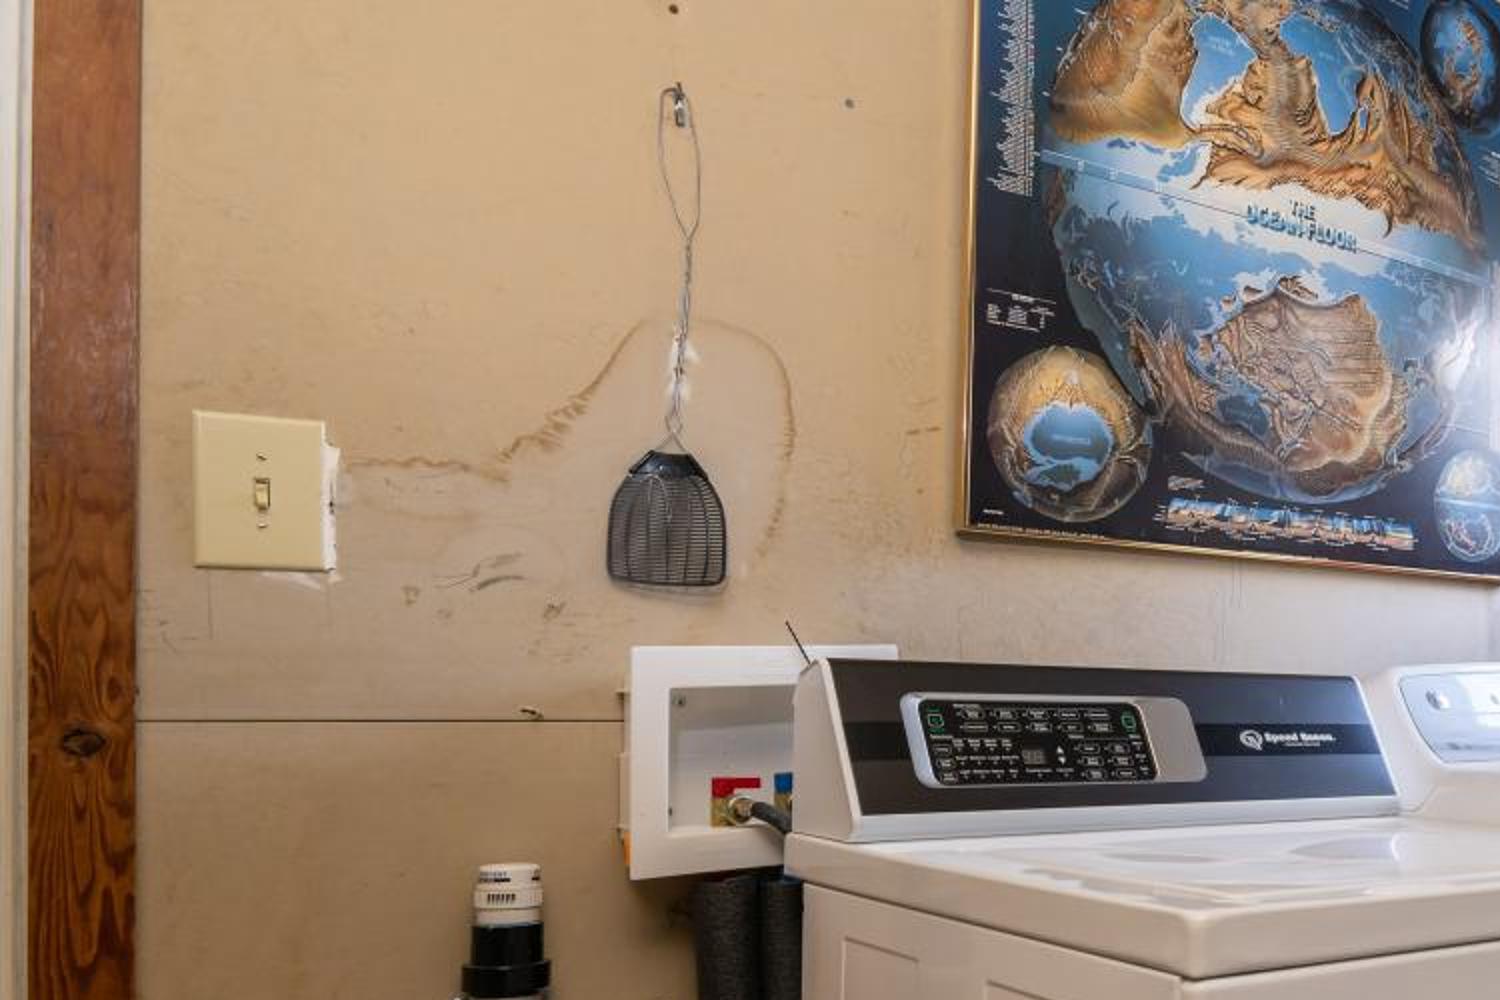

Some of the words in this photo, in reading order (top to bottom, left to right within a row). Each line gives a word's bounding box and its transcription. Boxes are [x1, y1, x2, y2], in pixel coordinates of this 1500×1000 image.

[1289, 199, 1316, 221] THE
[1246, 203, 1305, 239] OCEAN
[1307, 221, 1358, 254] FLOOR
